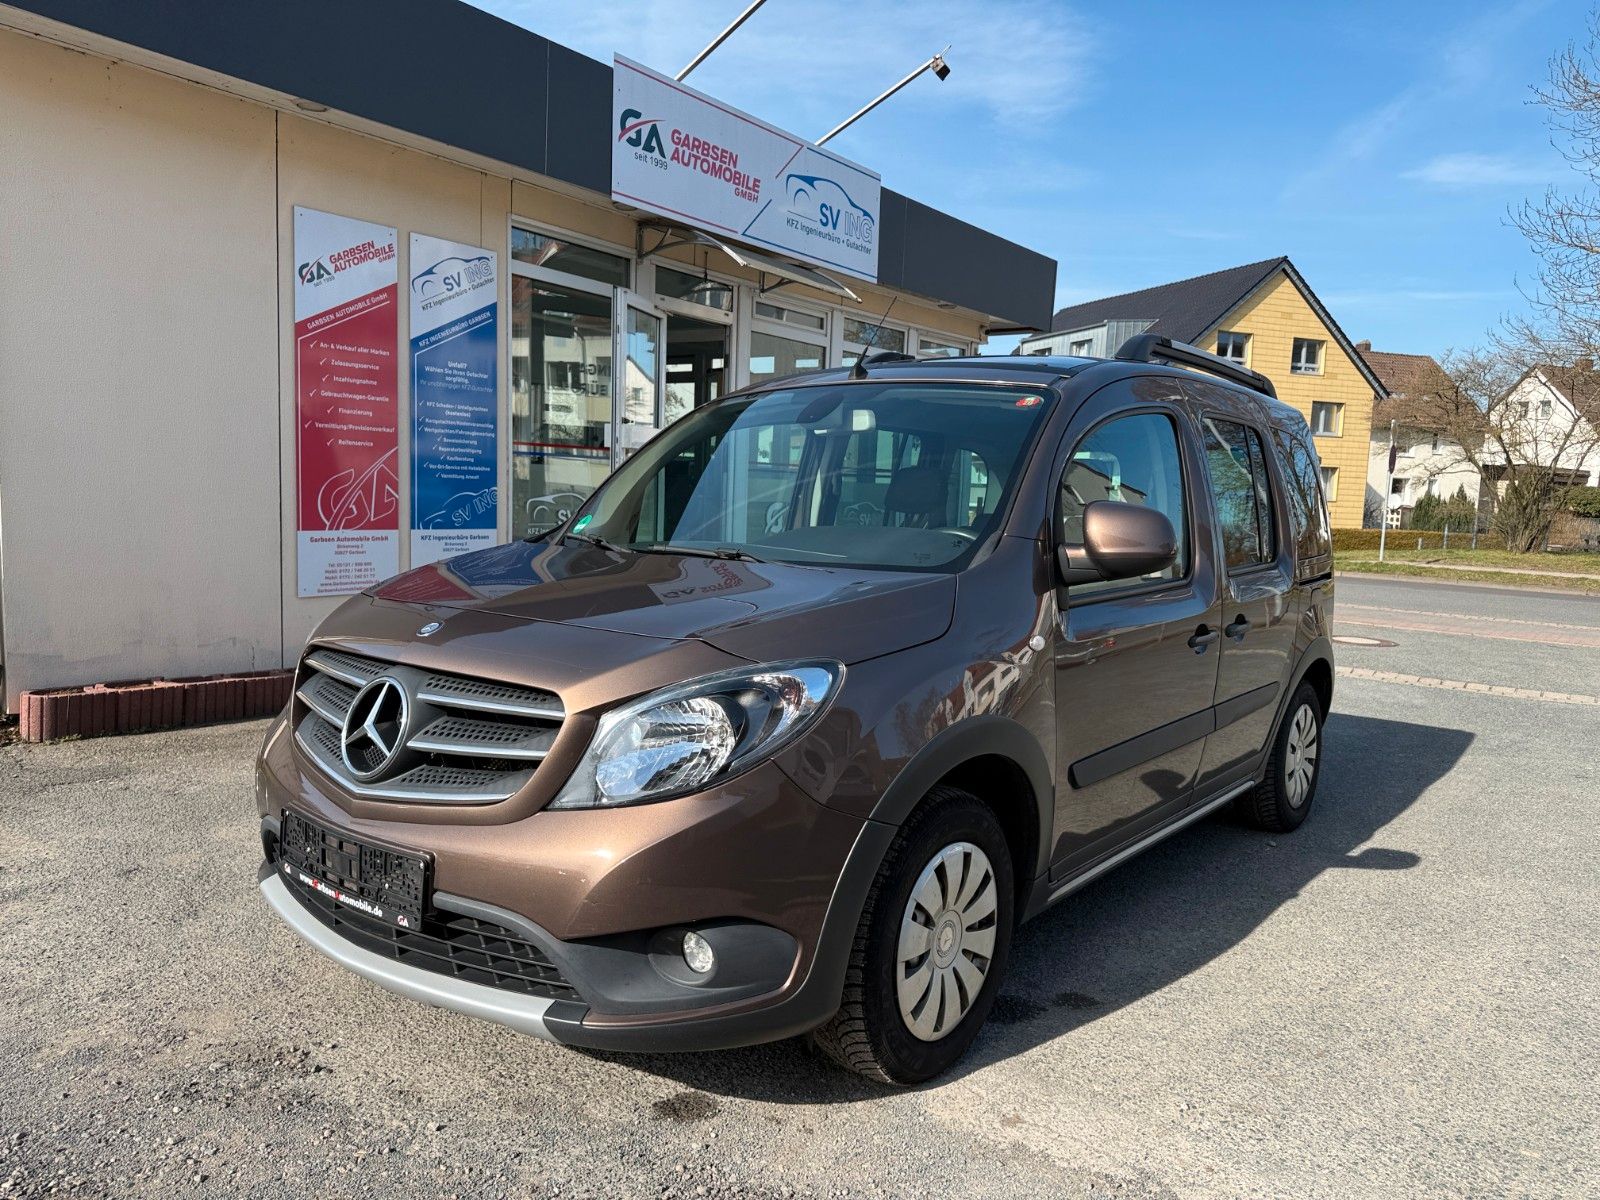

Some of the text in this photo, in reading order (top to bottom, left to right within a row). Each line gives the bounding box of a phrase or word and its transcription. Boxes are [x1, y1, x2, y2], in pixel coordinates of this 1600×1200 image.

[634, 152, 668, 170] seit 1999
[670, 128, 738, 168] GARBSEN
[670, 147, 761, 194] AUTOMOBILE
[734, 187, 759, 203] GMBH
[786, 216, 873, 255] KFZ Ingenieurbüro Gutachter
[819, 203, 873, 244] SV ING
[329, 240, 375, 264] GARBSEN
[334, 243, 395, 274] AUTOMOBILE
[378, 253, 396, 263] GMBH
[443, 260, 492, 291] SV ING
[421, 277, 495, 311] KFZ Ingenieurbüro Gutachter
[307, 313, 335, 329] GARBSEN
[335, 299, 370, 318] AUTOMOBILE
[418, 337, 429, 347] KFZ
[468, 311, 491, 325] GARBSEN
[335, 344, 357, 352] Verkauf
[338, 407, 373, 417] Finanzierung
[527, 527, 540, 535] KFZ
